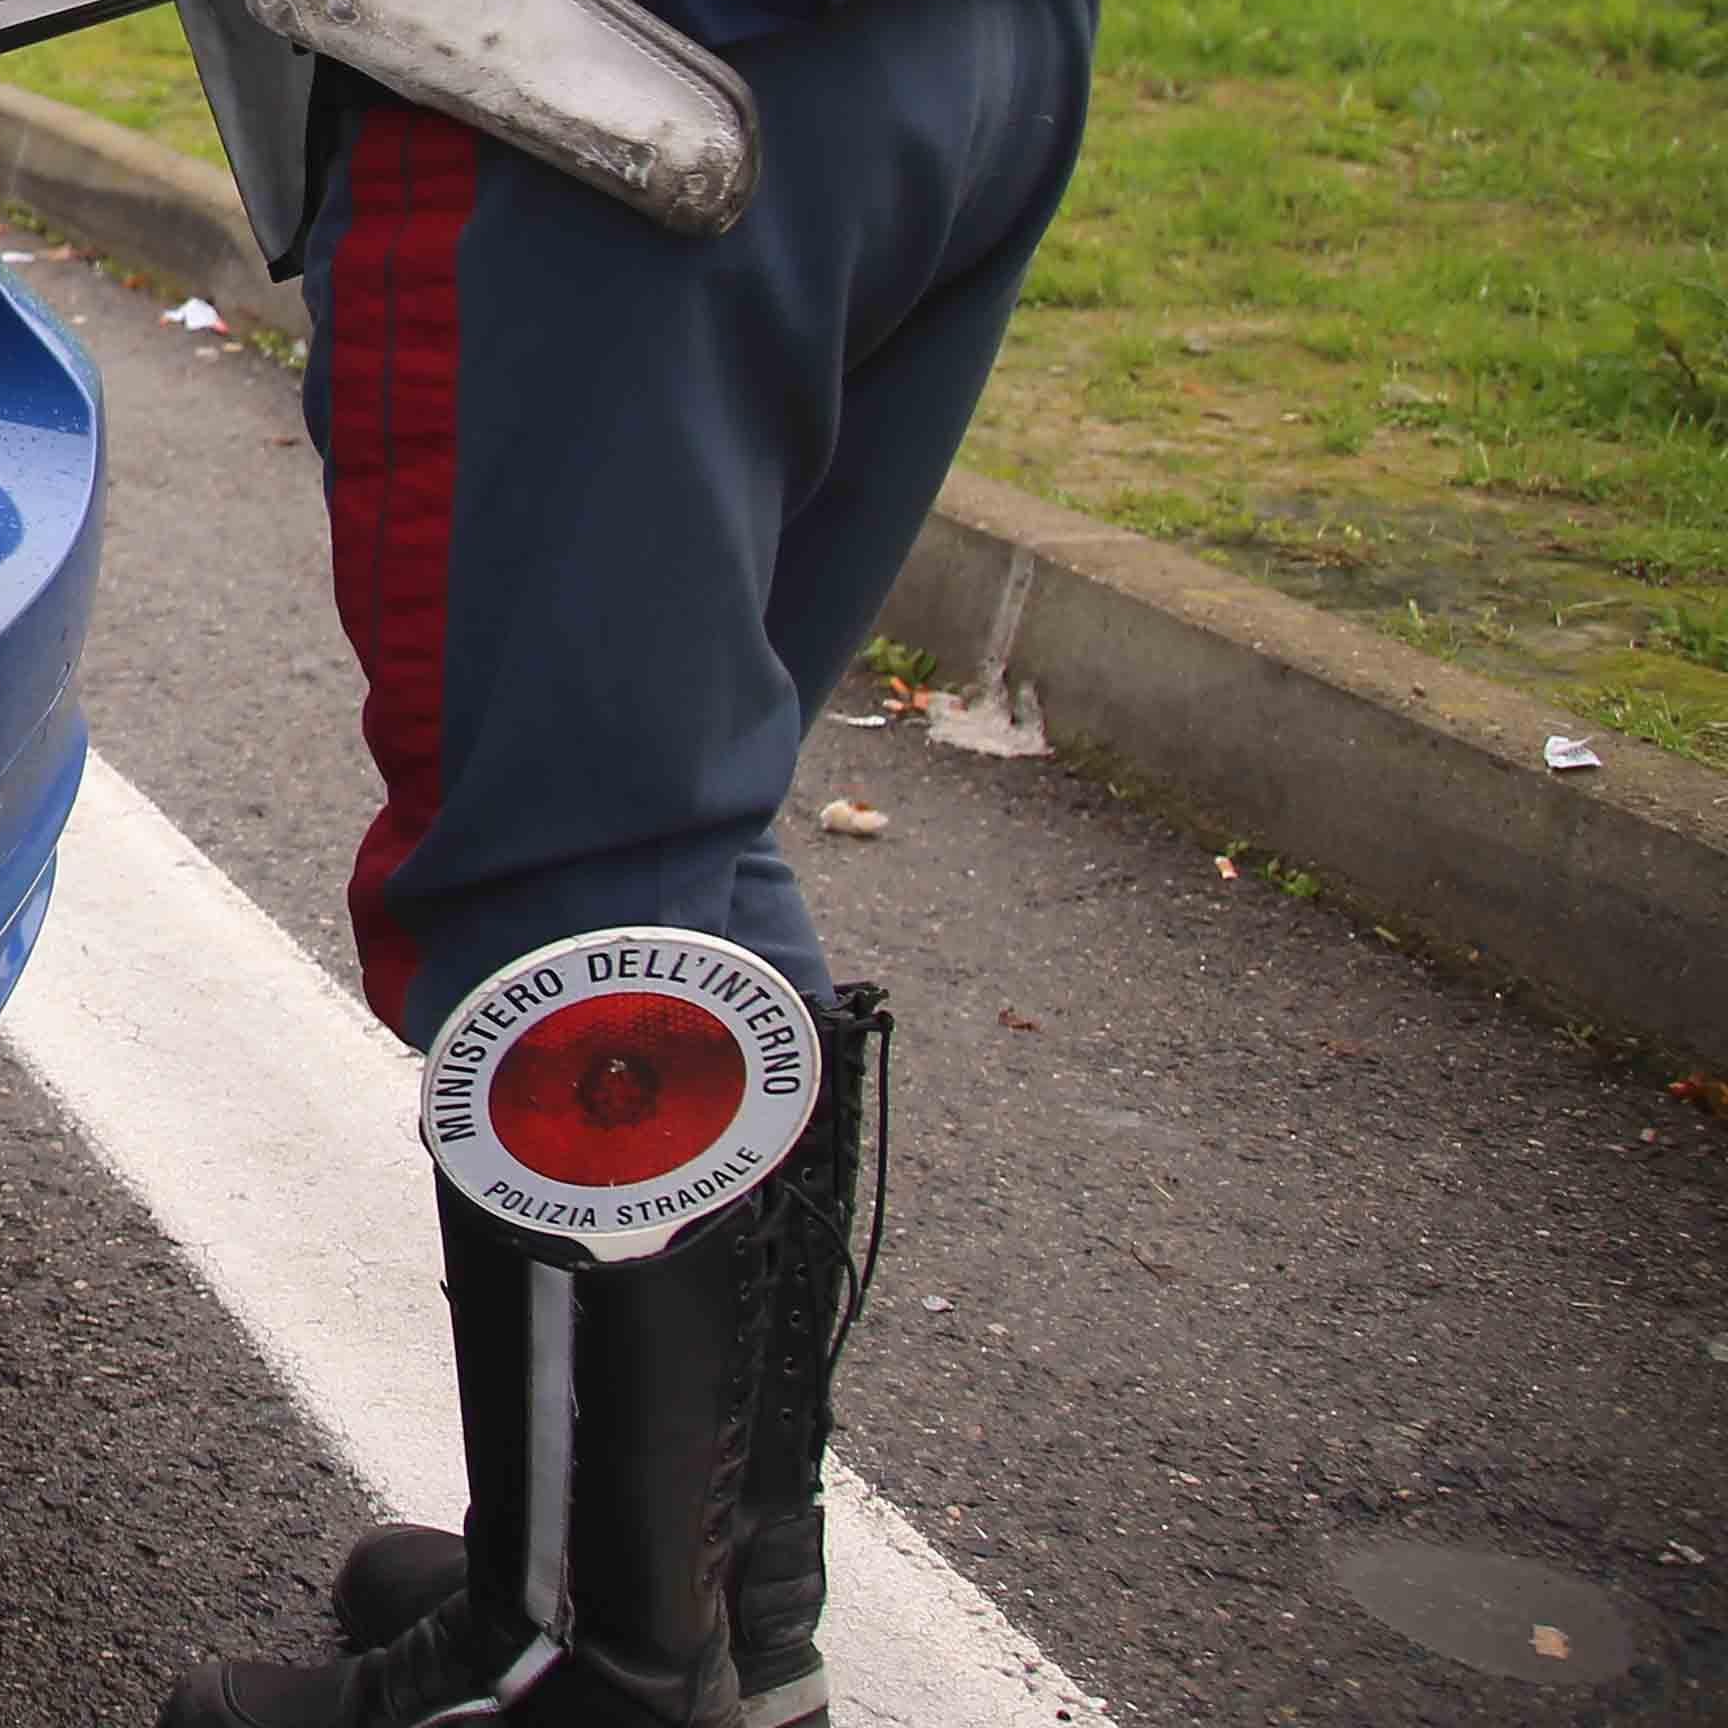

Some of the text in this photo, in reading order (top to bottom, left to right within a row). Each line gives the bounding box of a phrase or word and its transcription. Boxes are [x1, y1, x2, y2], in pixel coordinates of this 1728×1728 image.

[435, 948, 800, 1143] MINISTERO DELL'INTERNO
[483, 1146, 762, 1227] POLIZIA STRADALE
